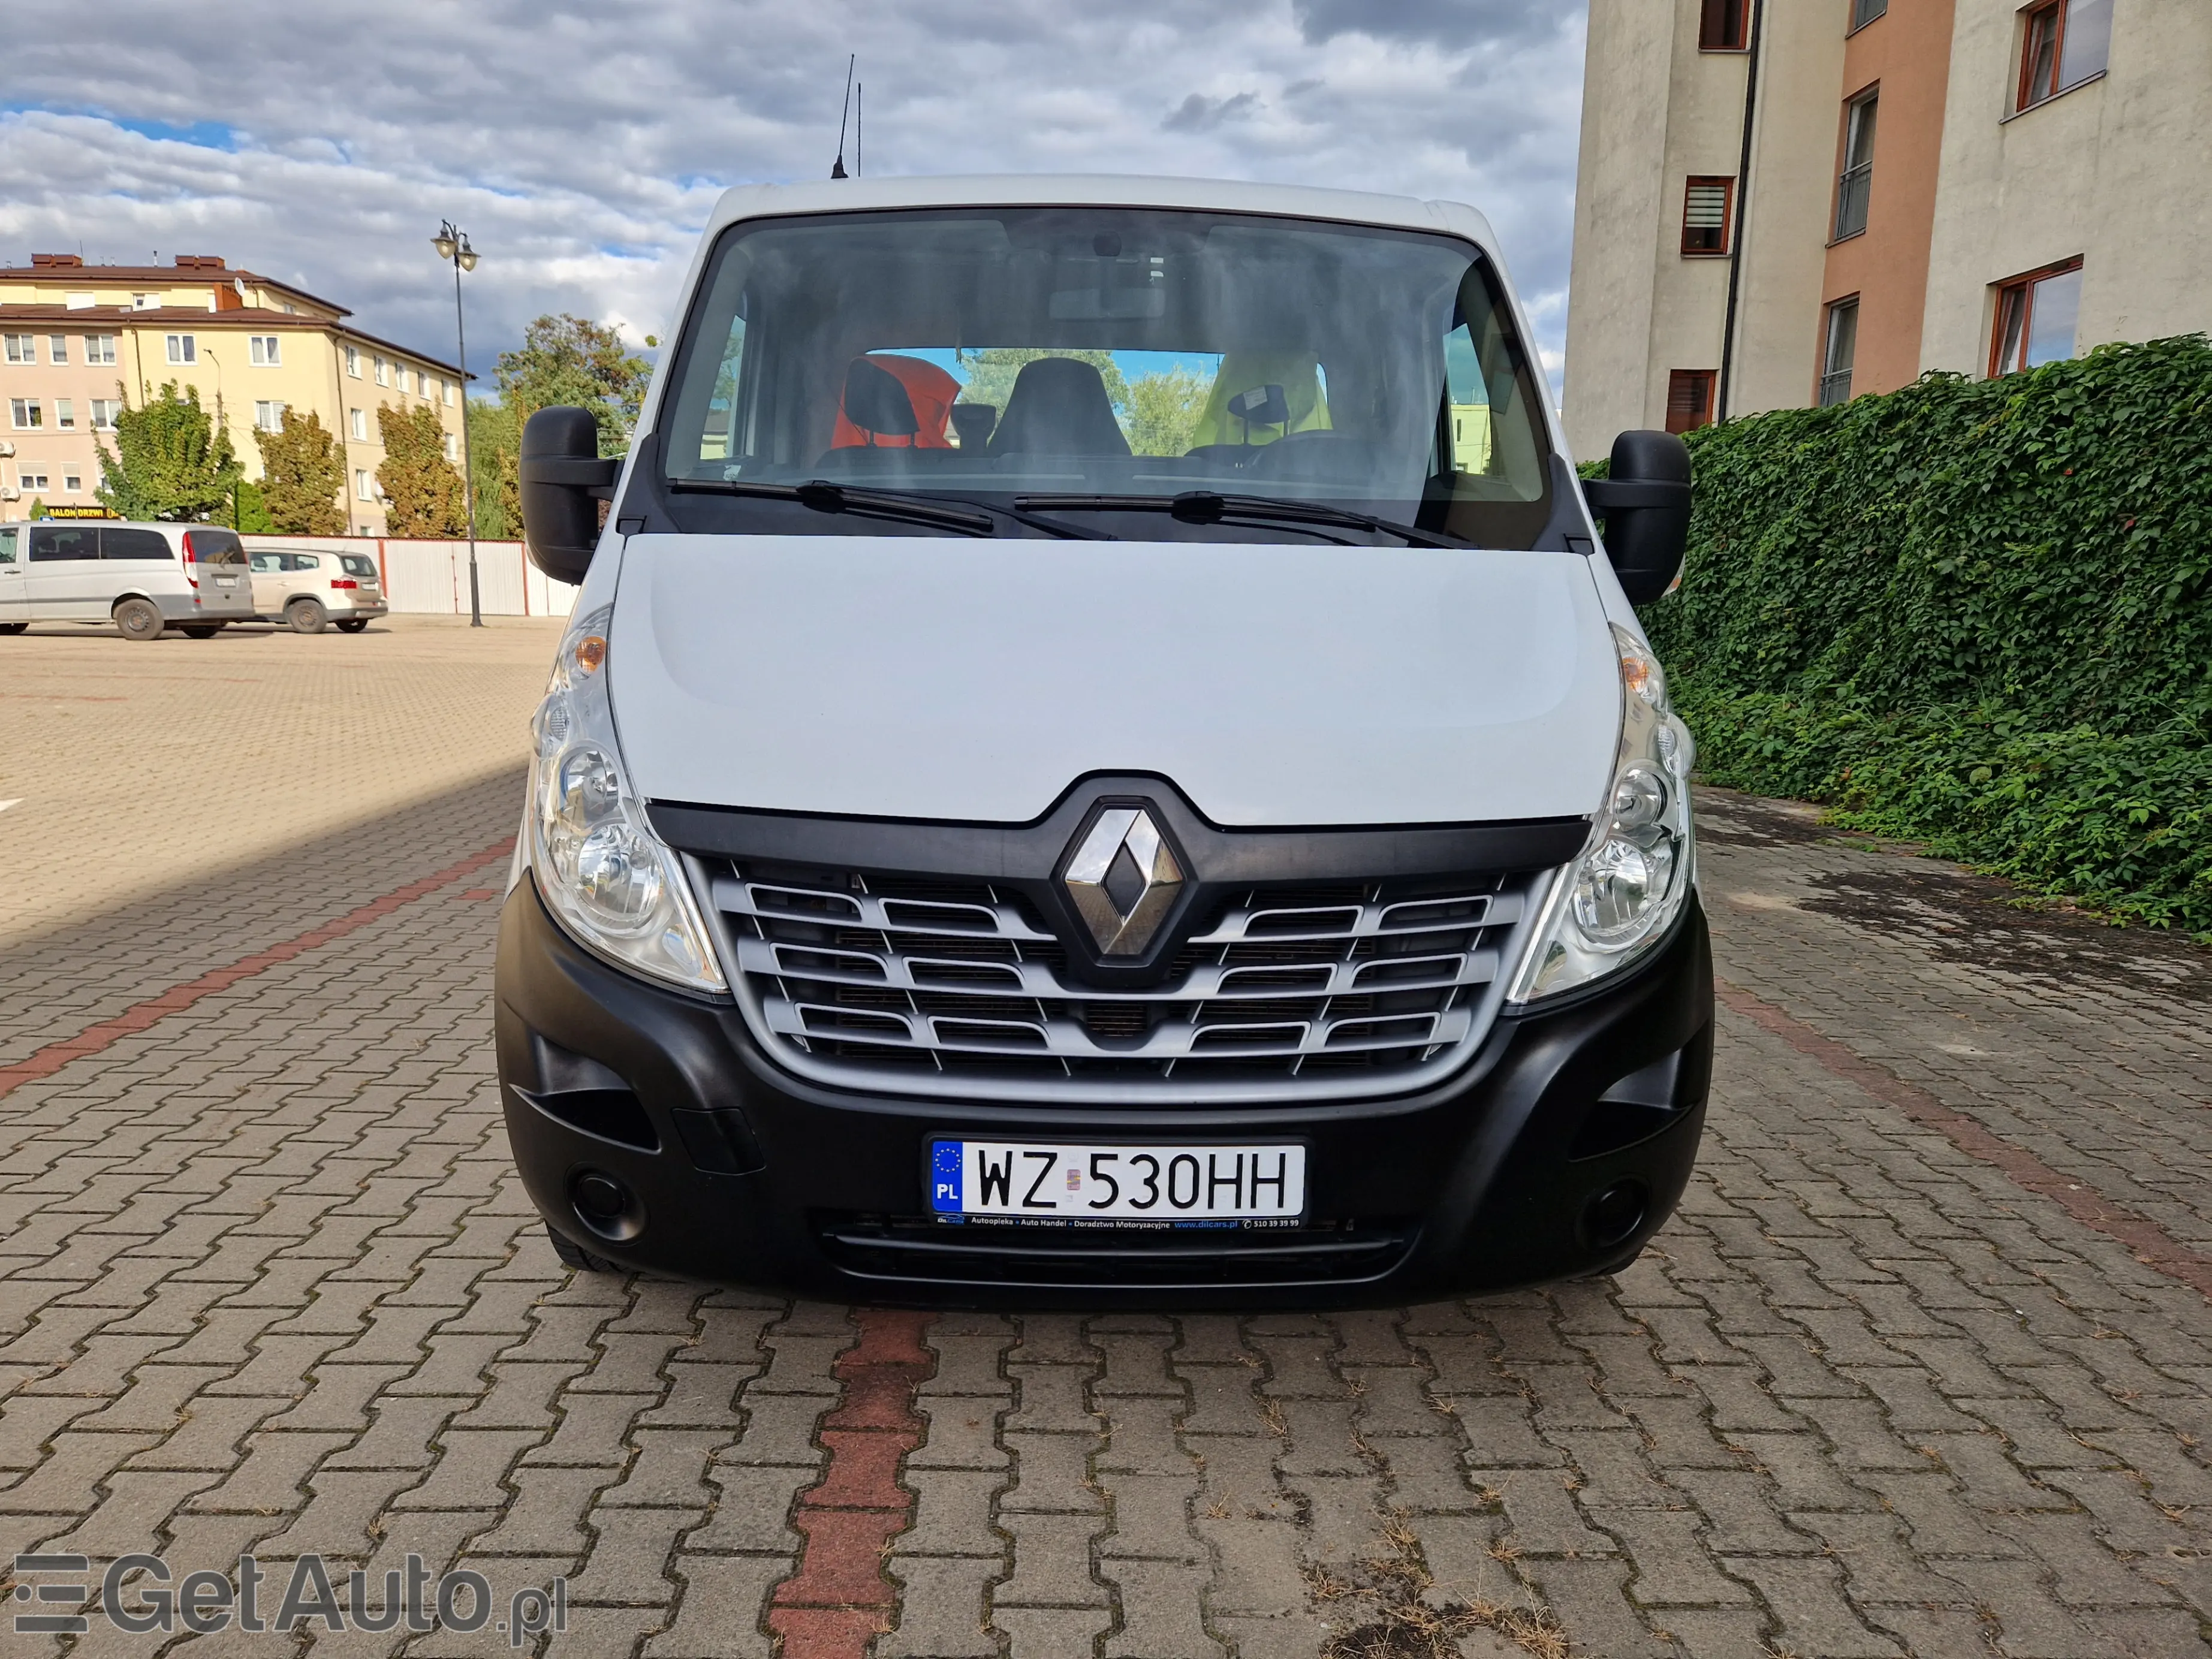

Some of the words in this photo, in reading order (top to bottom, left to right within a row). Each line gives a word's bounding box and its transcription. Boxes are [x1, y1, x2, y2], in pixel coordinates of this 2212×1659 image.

[978, 1150, 1057, 1208] WZ
[1087, 1152, 1286, 1209] 530HH
[937, 1184, 959, 1199] PL
[971, 1217, 1013, 1226] Autoopieka
[1116, 1221, 1170, 1229] Motoryzacyjne
